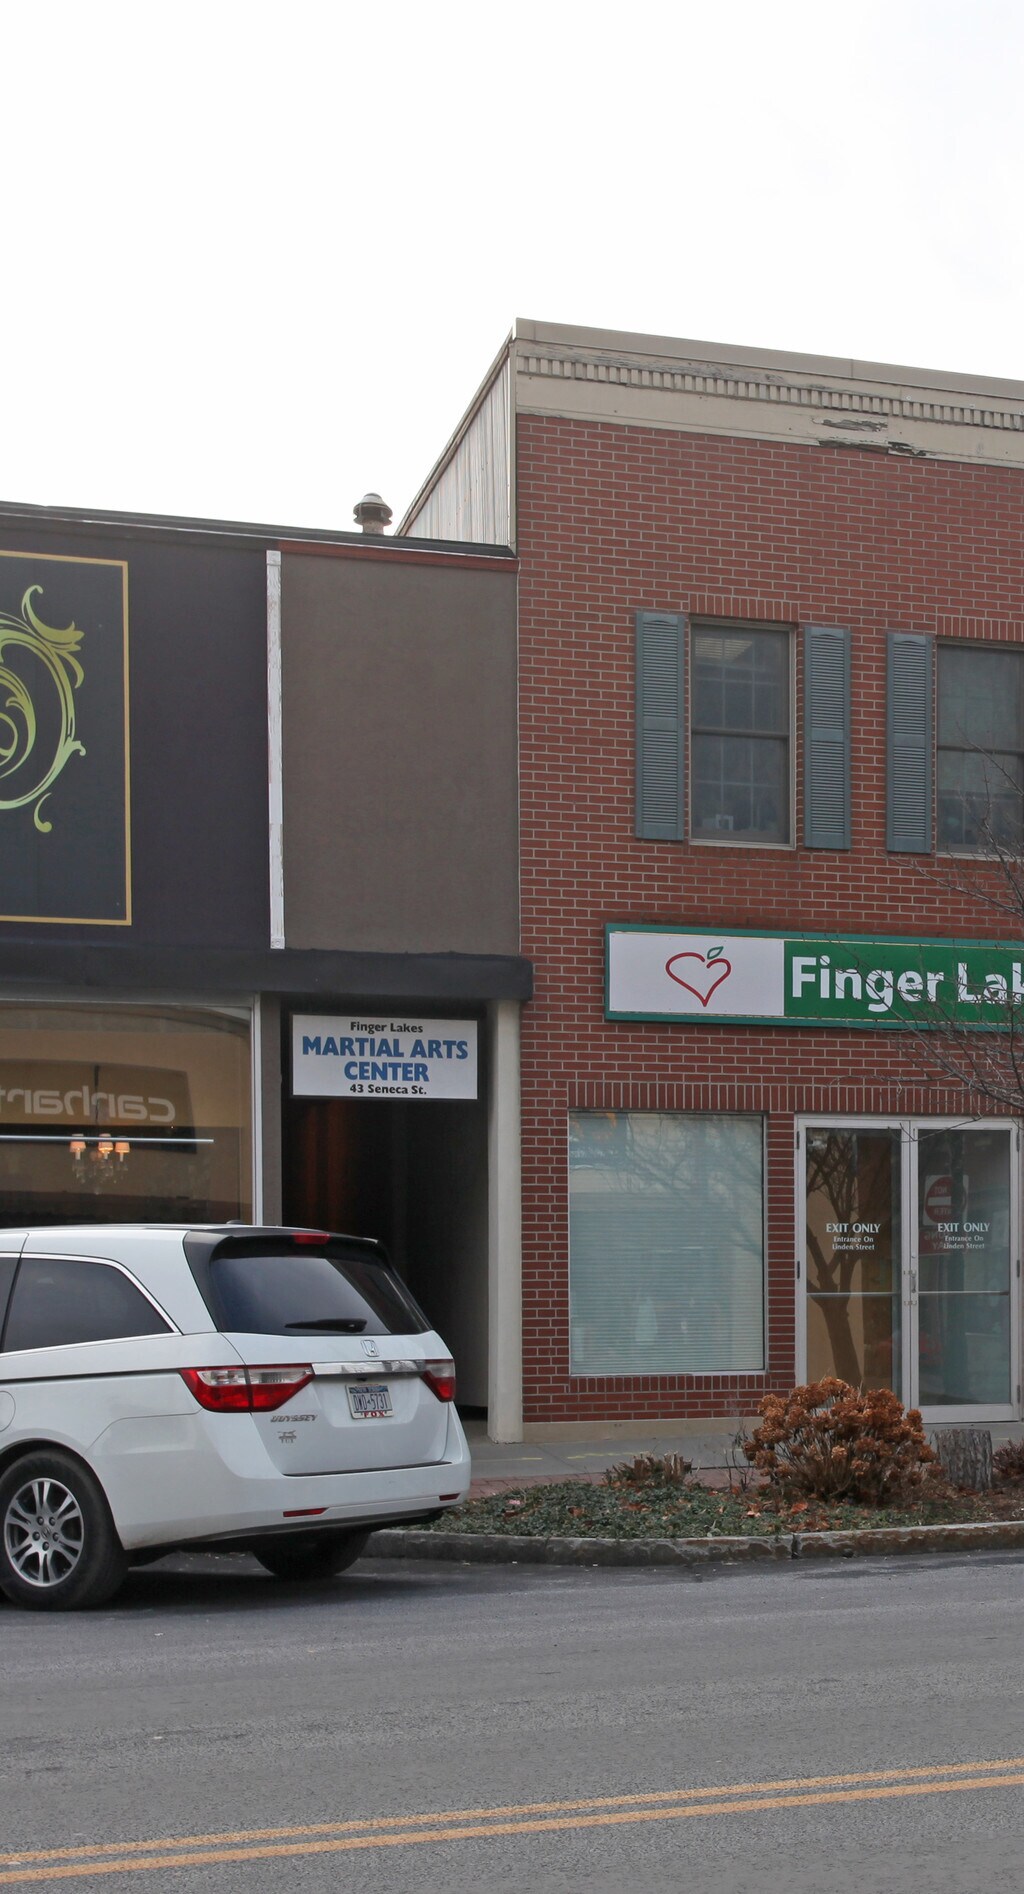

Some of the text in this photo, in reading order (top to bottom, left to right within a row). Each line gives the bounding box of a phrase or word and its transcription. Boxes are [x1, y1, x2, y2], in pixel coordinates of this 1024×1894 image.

[792, 955, 944, 1012] Finger
[350, 1021, 423, 1034] Finger Lakes
[302, 1036, 468, 1059] MARTIAL ARTS
[344, 1061, 430, 1082] CENTER
[349, 1084, 427, 1095] 43 Seneca St.
[826, 1223, 881, 1233] EXIT ONLY
[937, 1222, 991, 1232] EXIT ONLY
